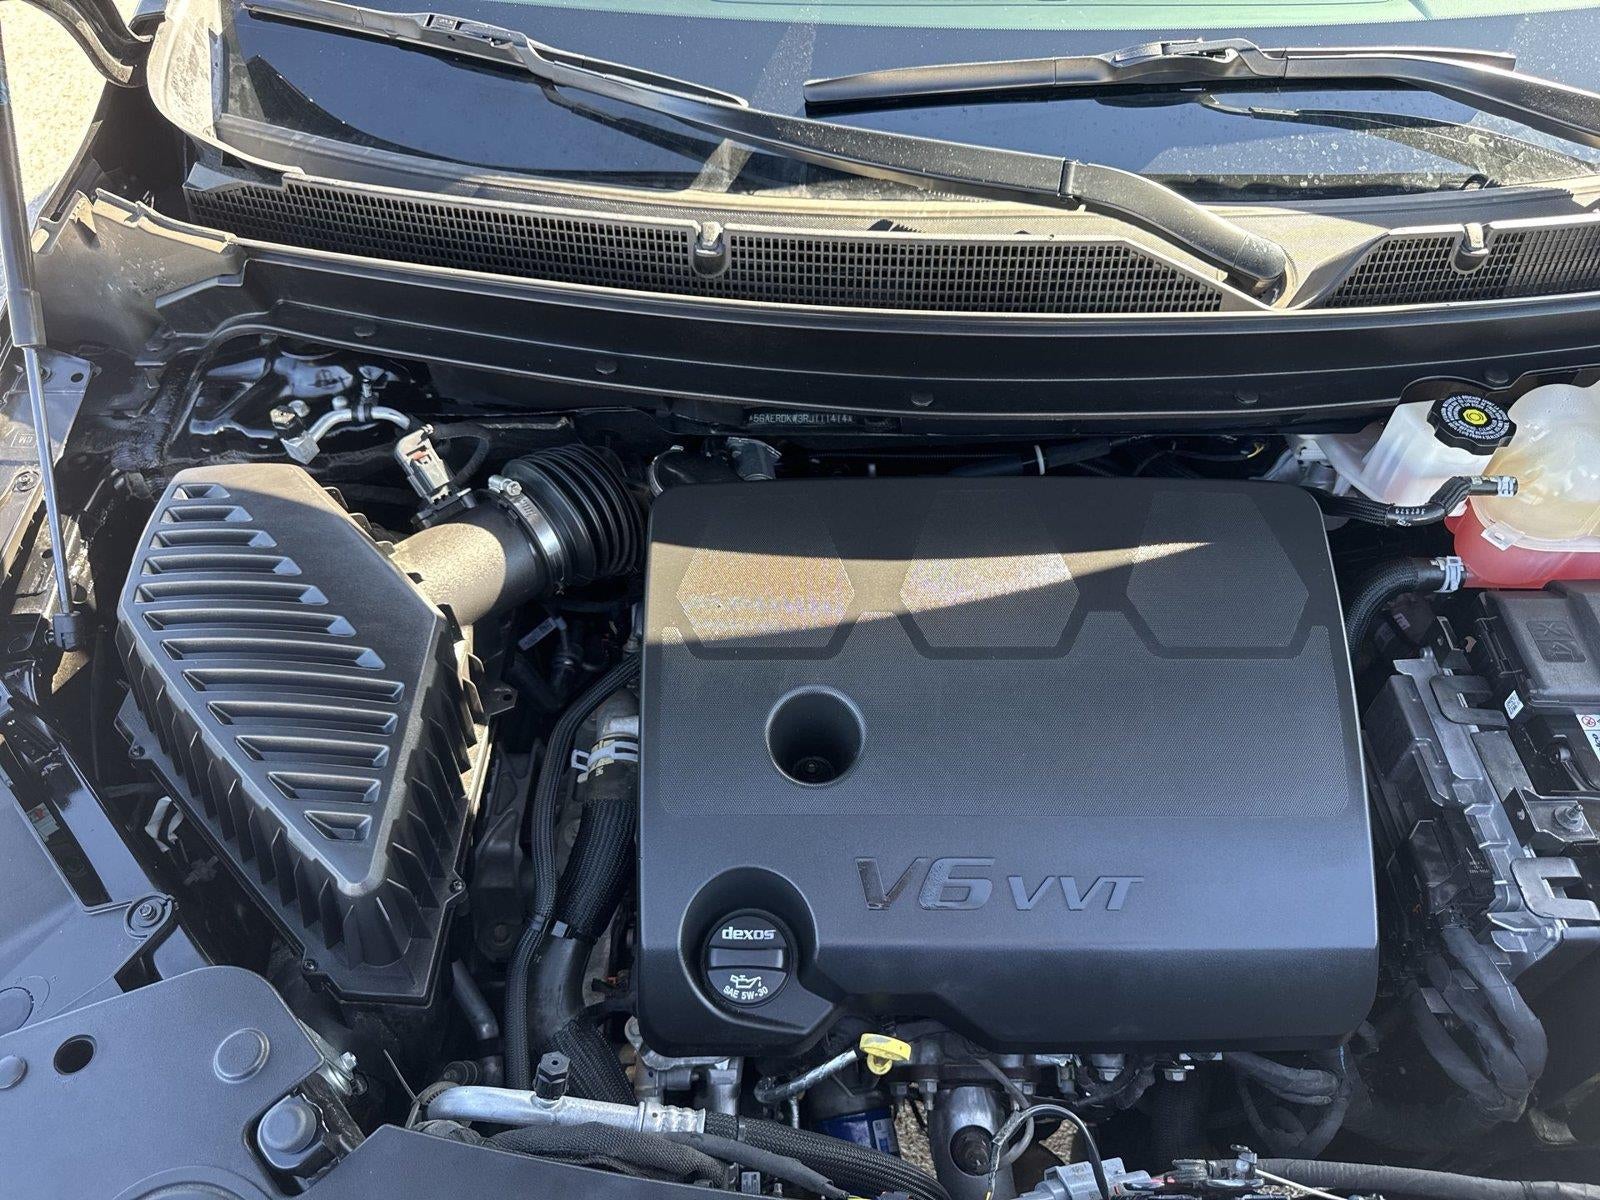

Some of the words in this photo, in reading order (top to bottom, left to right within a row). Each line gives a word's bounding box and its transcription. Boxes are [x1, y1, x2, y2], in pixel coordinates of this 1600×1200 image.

[854, 857, 996, 910] V6
[1008, 875, 1145, 911] VVT
[721, 926, 777, 941] dexos
[723, 985, 740, 999] SAE
[741, 986, 769, 1000] 5W-30
